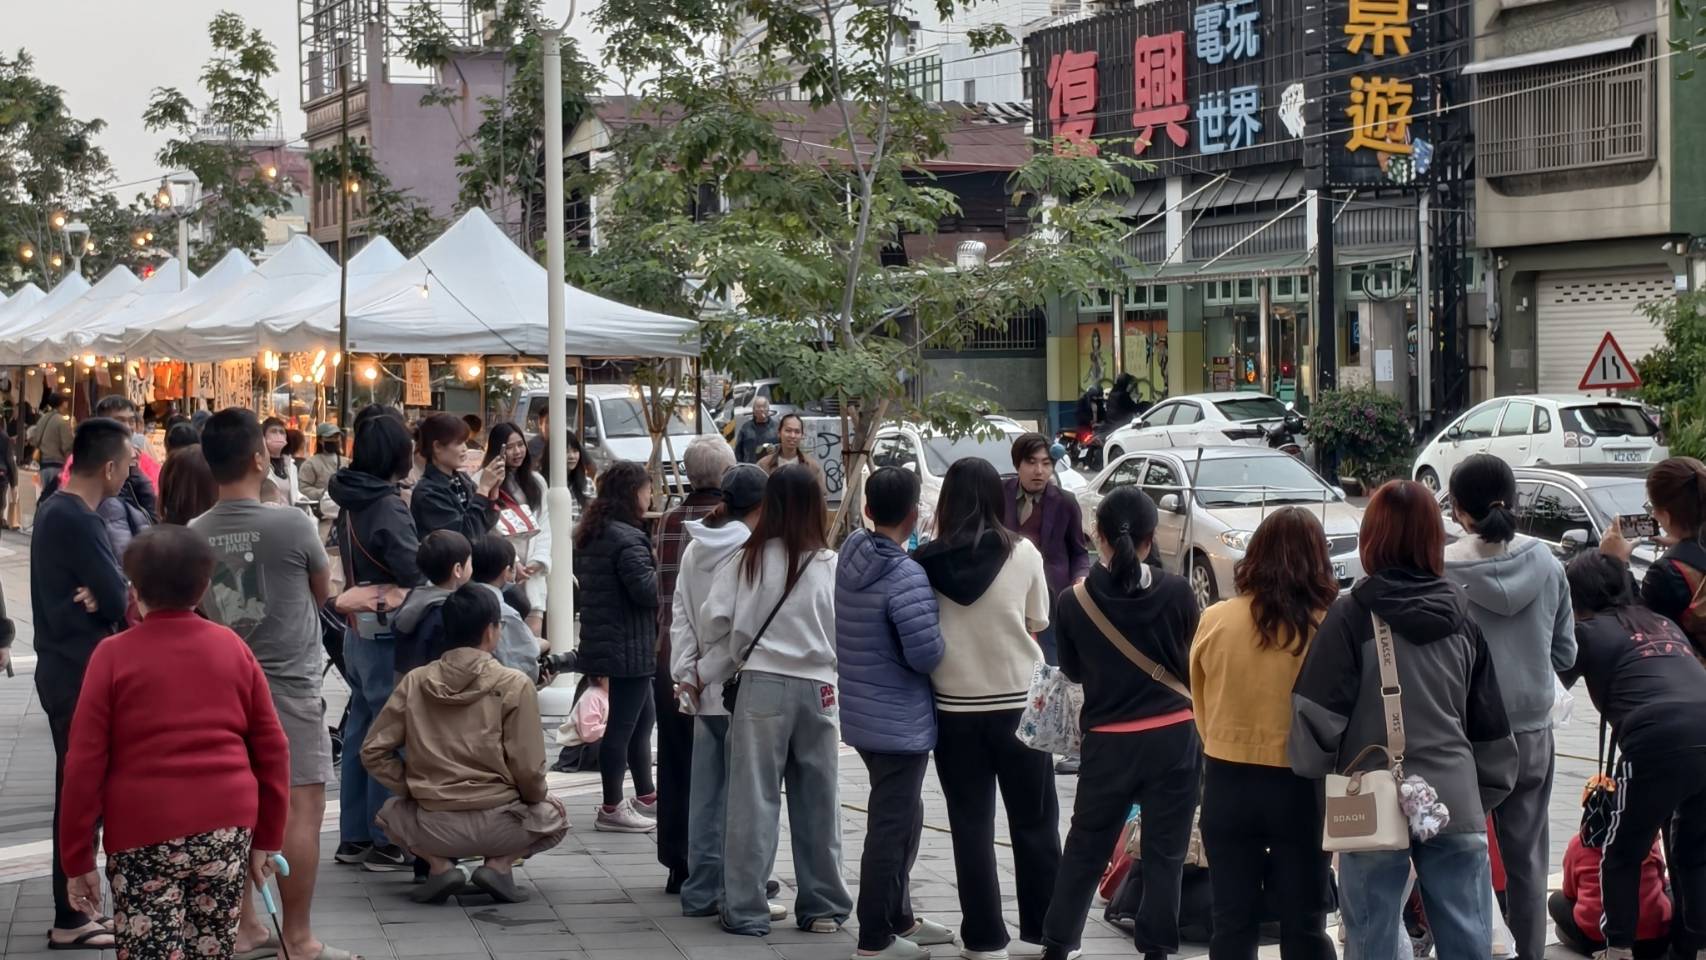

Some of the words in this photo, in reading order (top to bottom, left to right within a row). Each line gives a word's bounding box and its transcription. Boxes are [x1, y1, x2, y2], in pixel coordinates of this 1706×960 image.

[1194, 0, 1260, 64] 電玩
[1047, 31, 1190, 157] 復興
[1344, 0, 1414, 154] 桌遊
[1196, 85, 1262, 154] 世界
[207, 531, 261, 547] RTHUR'S
